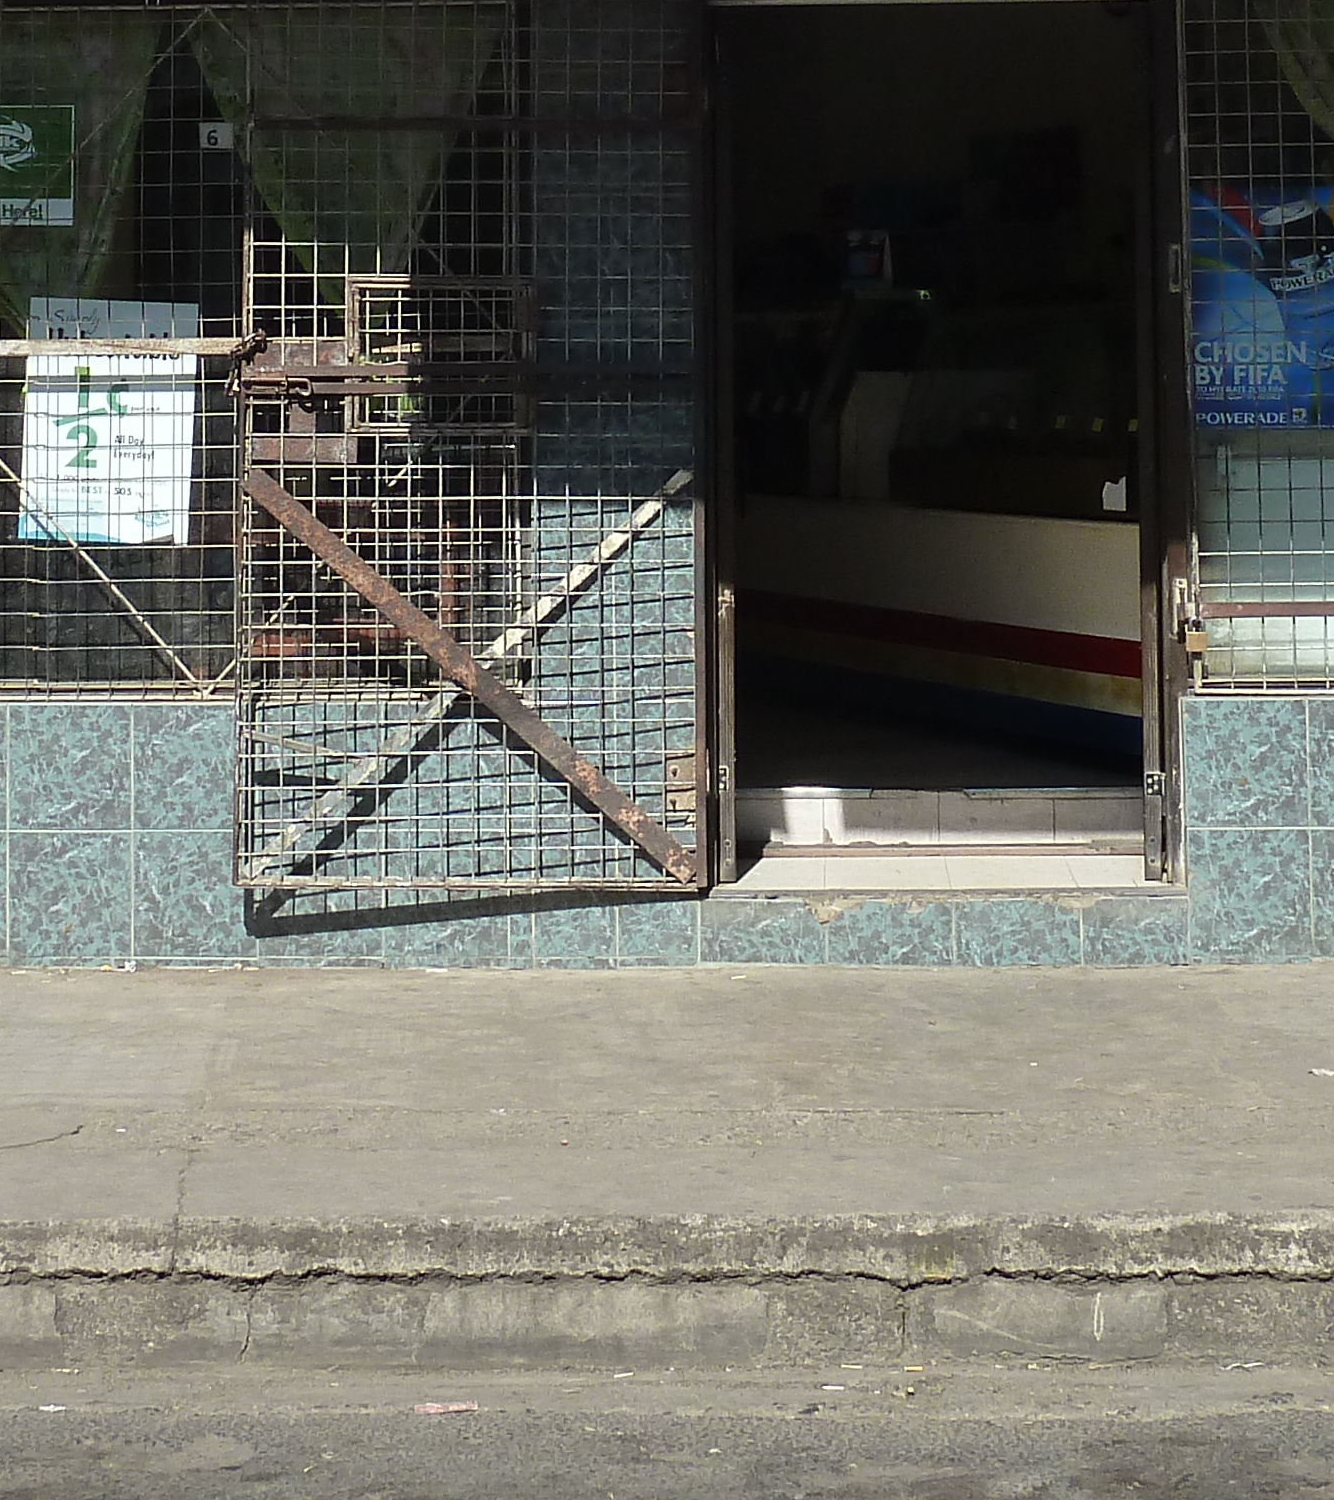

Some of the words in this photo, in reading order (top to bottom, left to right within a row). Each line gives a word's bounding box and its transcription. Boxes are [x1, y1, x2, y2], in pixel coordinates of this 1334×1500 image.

[207, 130, 219, 147] 6
[1194, 341, 1307, 364] CHOSEN
[1195, 364, 1224, 385] BY
[1233, 364, 1288, 386] FIFA
